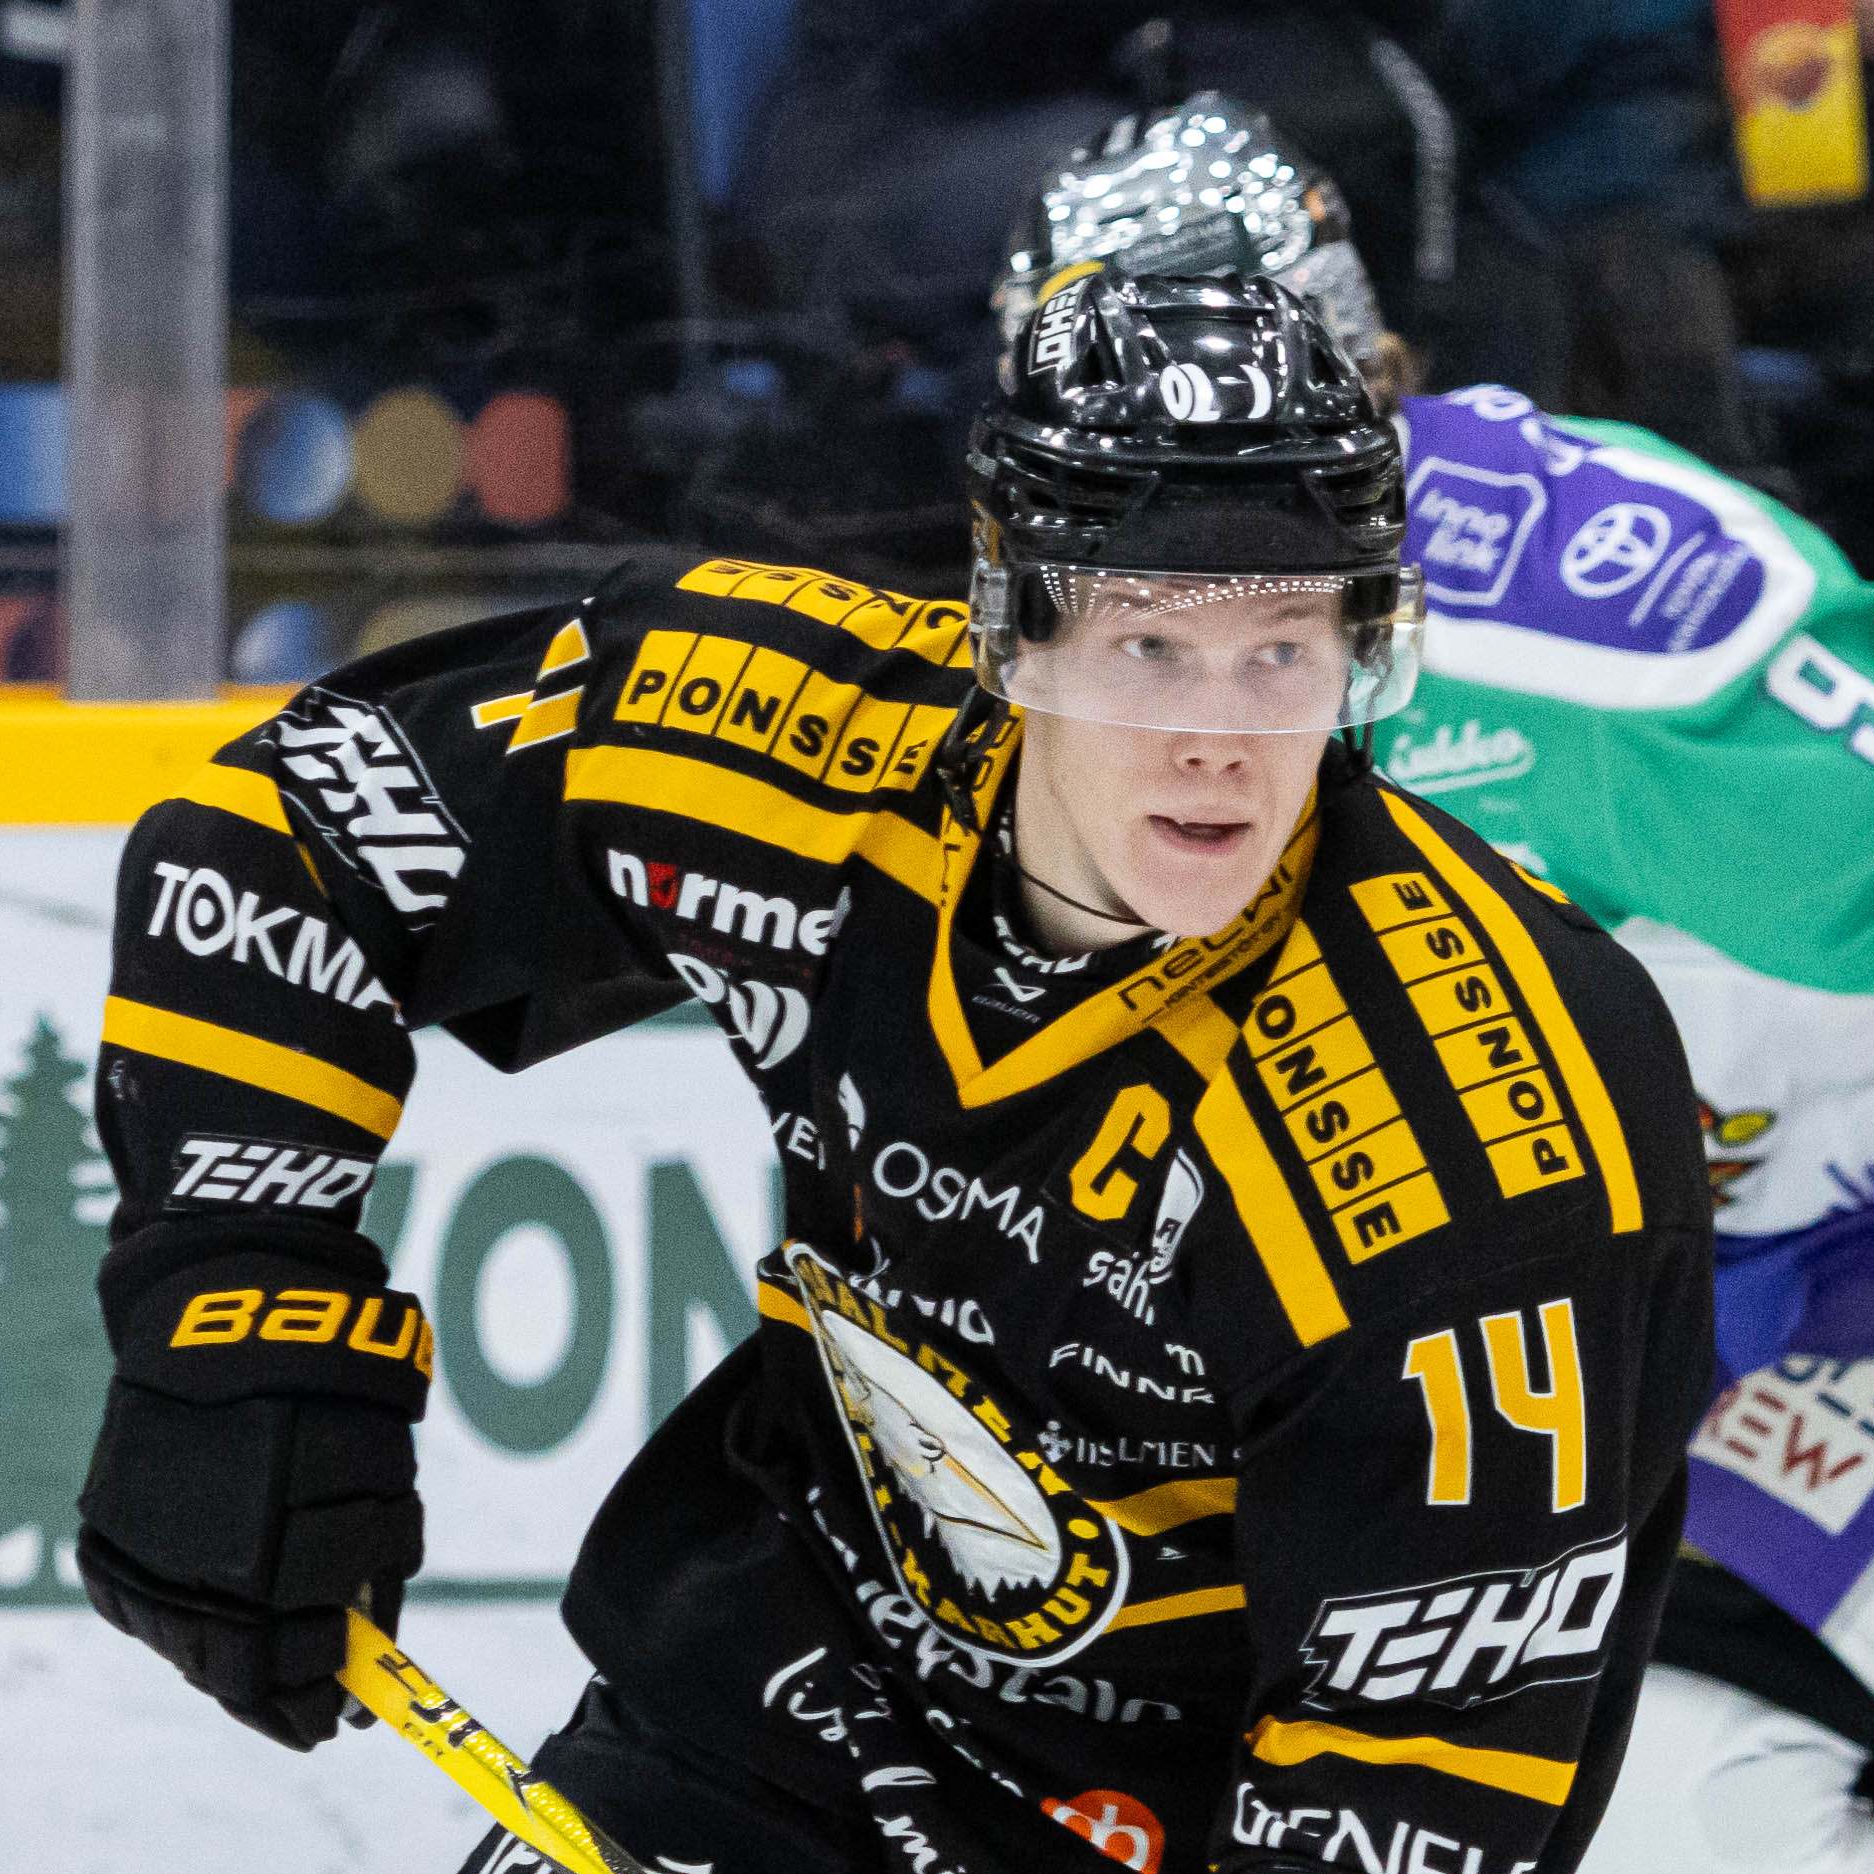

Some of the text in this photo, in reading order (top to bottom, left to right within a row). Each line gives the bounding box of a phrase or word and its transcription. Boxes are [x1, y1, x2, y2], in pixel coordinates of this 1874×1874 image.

[1258, 991, 1403, 1249] ONSSE
[1391, 879, 1571, 1176] PONSSE
[172, 1139, 375, 1208] TEHO
[1069, 1082, 1172, 1221] C
[1402, 1297, 1588, 1514] 14
[1324, 1537, 1627, 1702] TEHO
